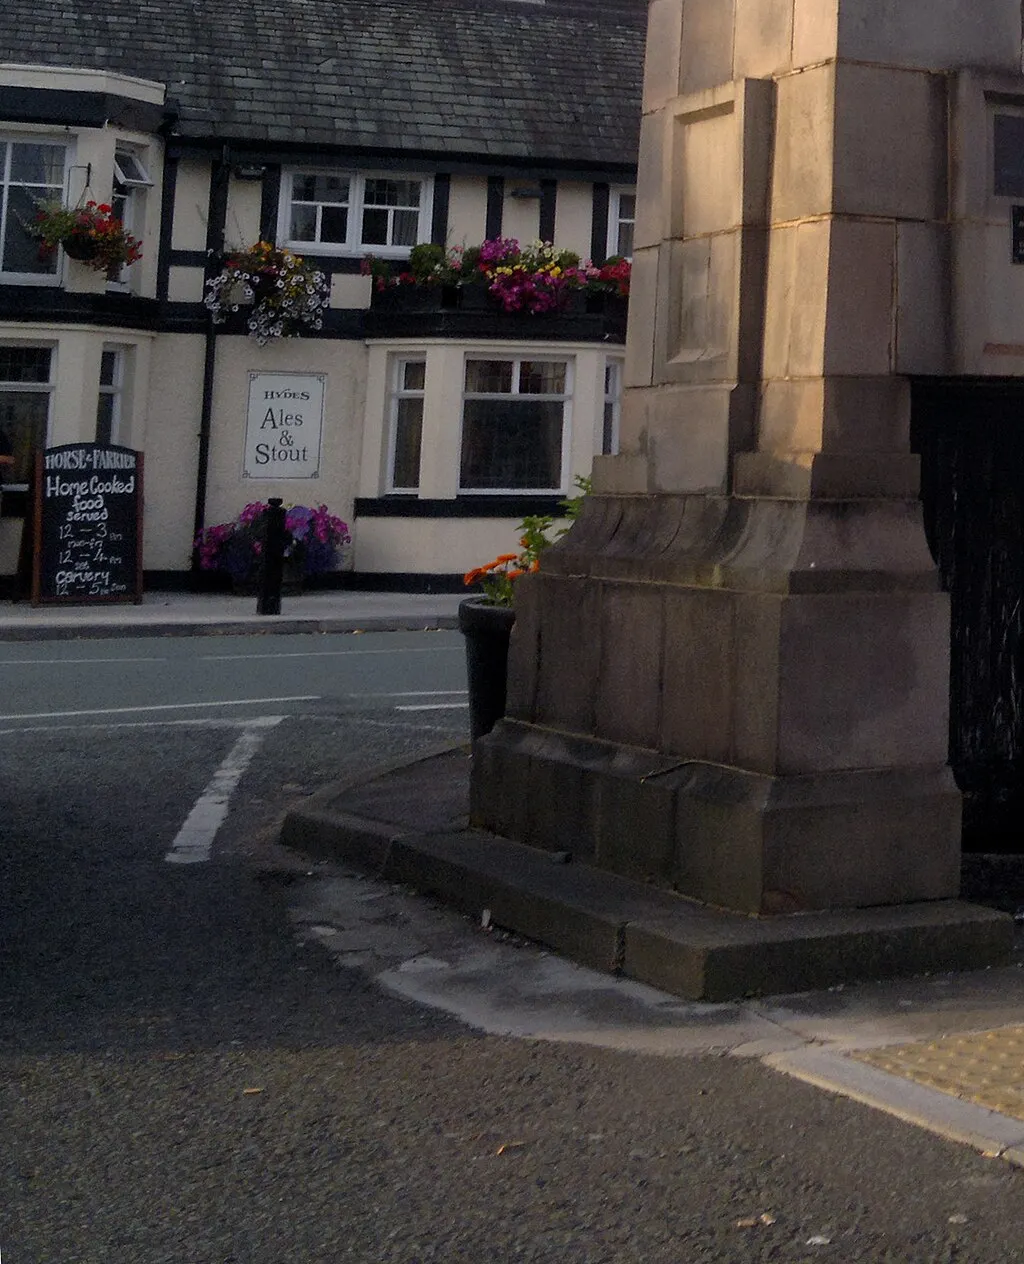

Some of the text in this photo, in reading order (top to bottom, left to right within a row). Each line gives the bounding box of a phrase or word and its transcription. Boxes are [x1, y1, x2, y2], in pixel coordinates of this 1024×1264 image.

[264, 388, 310, 400] HYDES
[260, 407, 303, 429] Ales
[280, 430, 293, 446] &
[45, 450, 87, 469] HORSE
[93, 449, 136, 469] FARRIER
[255, 443, 308, 464] Stout
[46, 475, 135, 497] Home Cooked
[72, 495, 104, 512] food
[66, 508, 108, 521] served
[60, 524, 74, 539] 12
[59, 550, 73, 563] 12
[56, 584, 69, 595] 12
